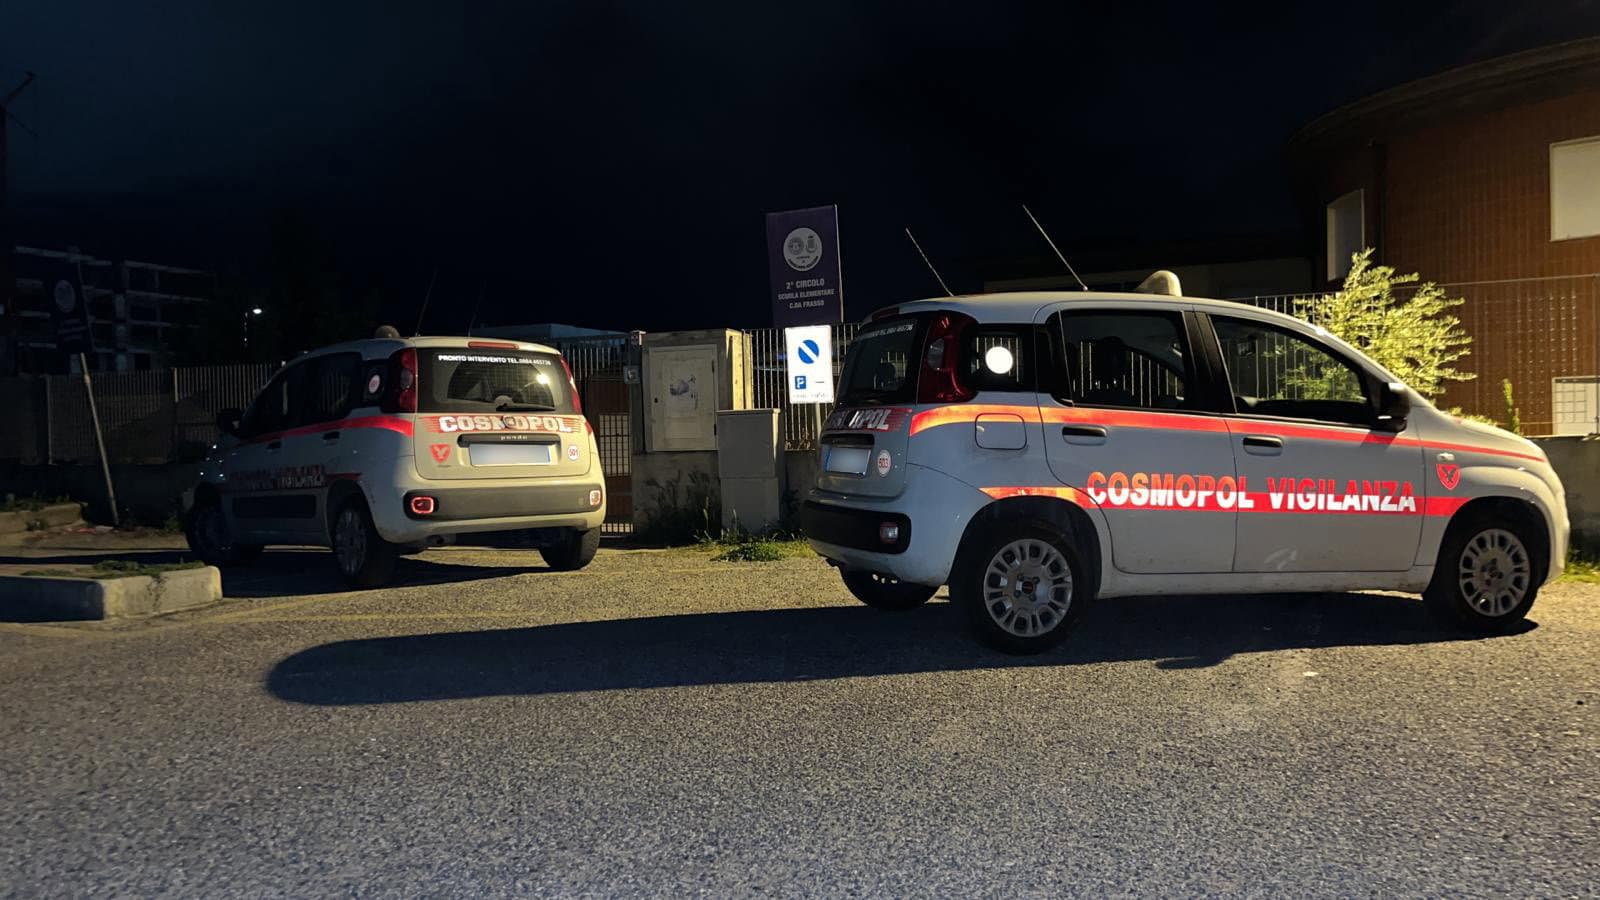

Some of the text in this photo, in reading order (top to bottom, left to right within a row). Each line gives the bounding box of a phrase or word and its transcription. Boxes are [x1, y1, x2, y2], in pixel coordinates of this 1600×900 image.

[795, 278, 825, 289] CIRCOLO
[799, 288, 835, 298] ELEMENTARE
[467, 356, 507, 364] INTERVENTO
[796, 377, 805, 389] P
[1087, 471, 1417, 512] COSMOPOL VIGILANZA
